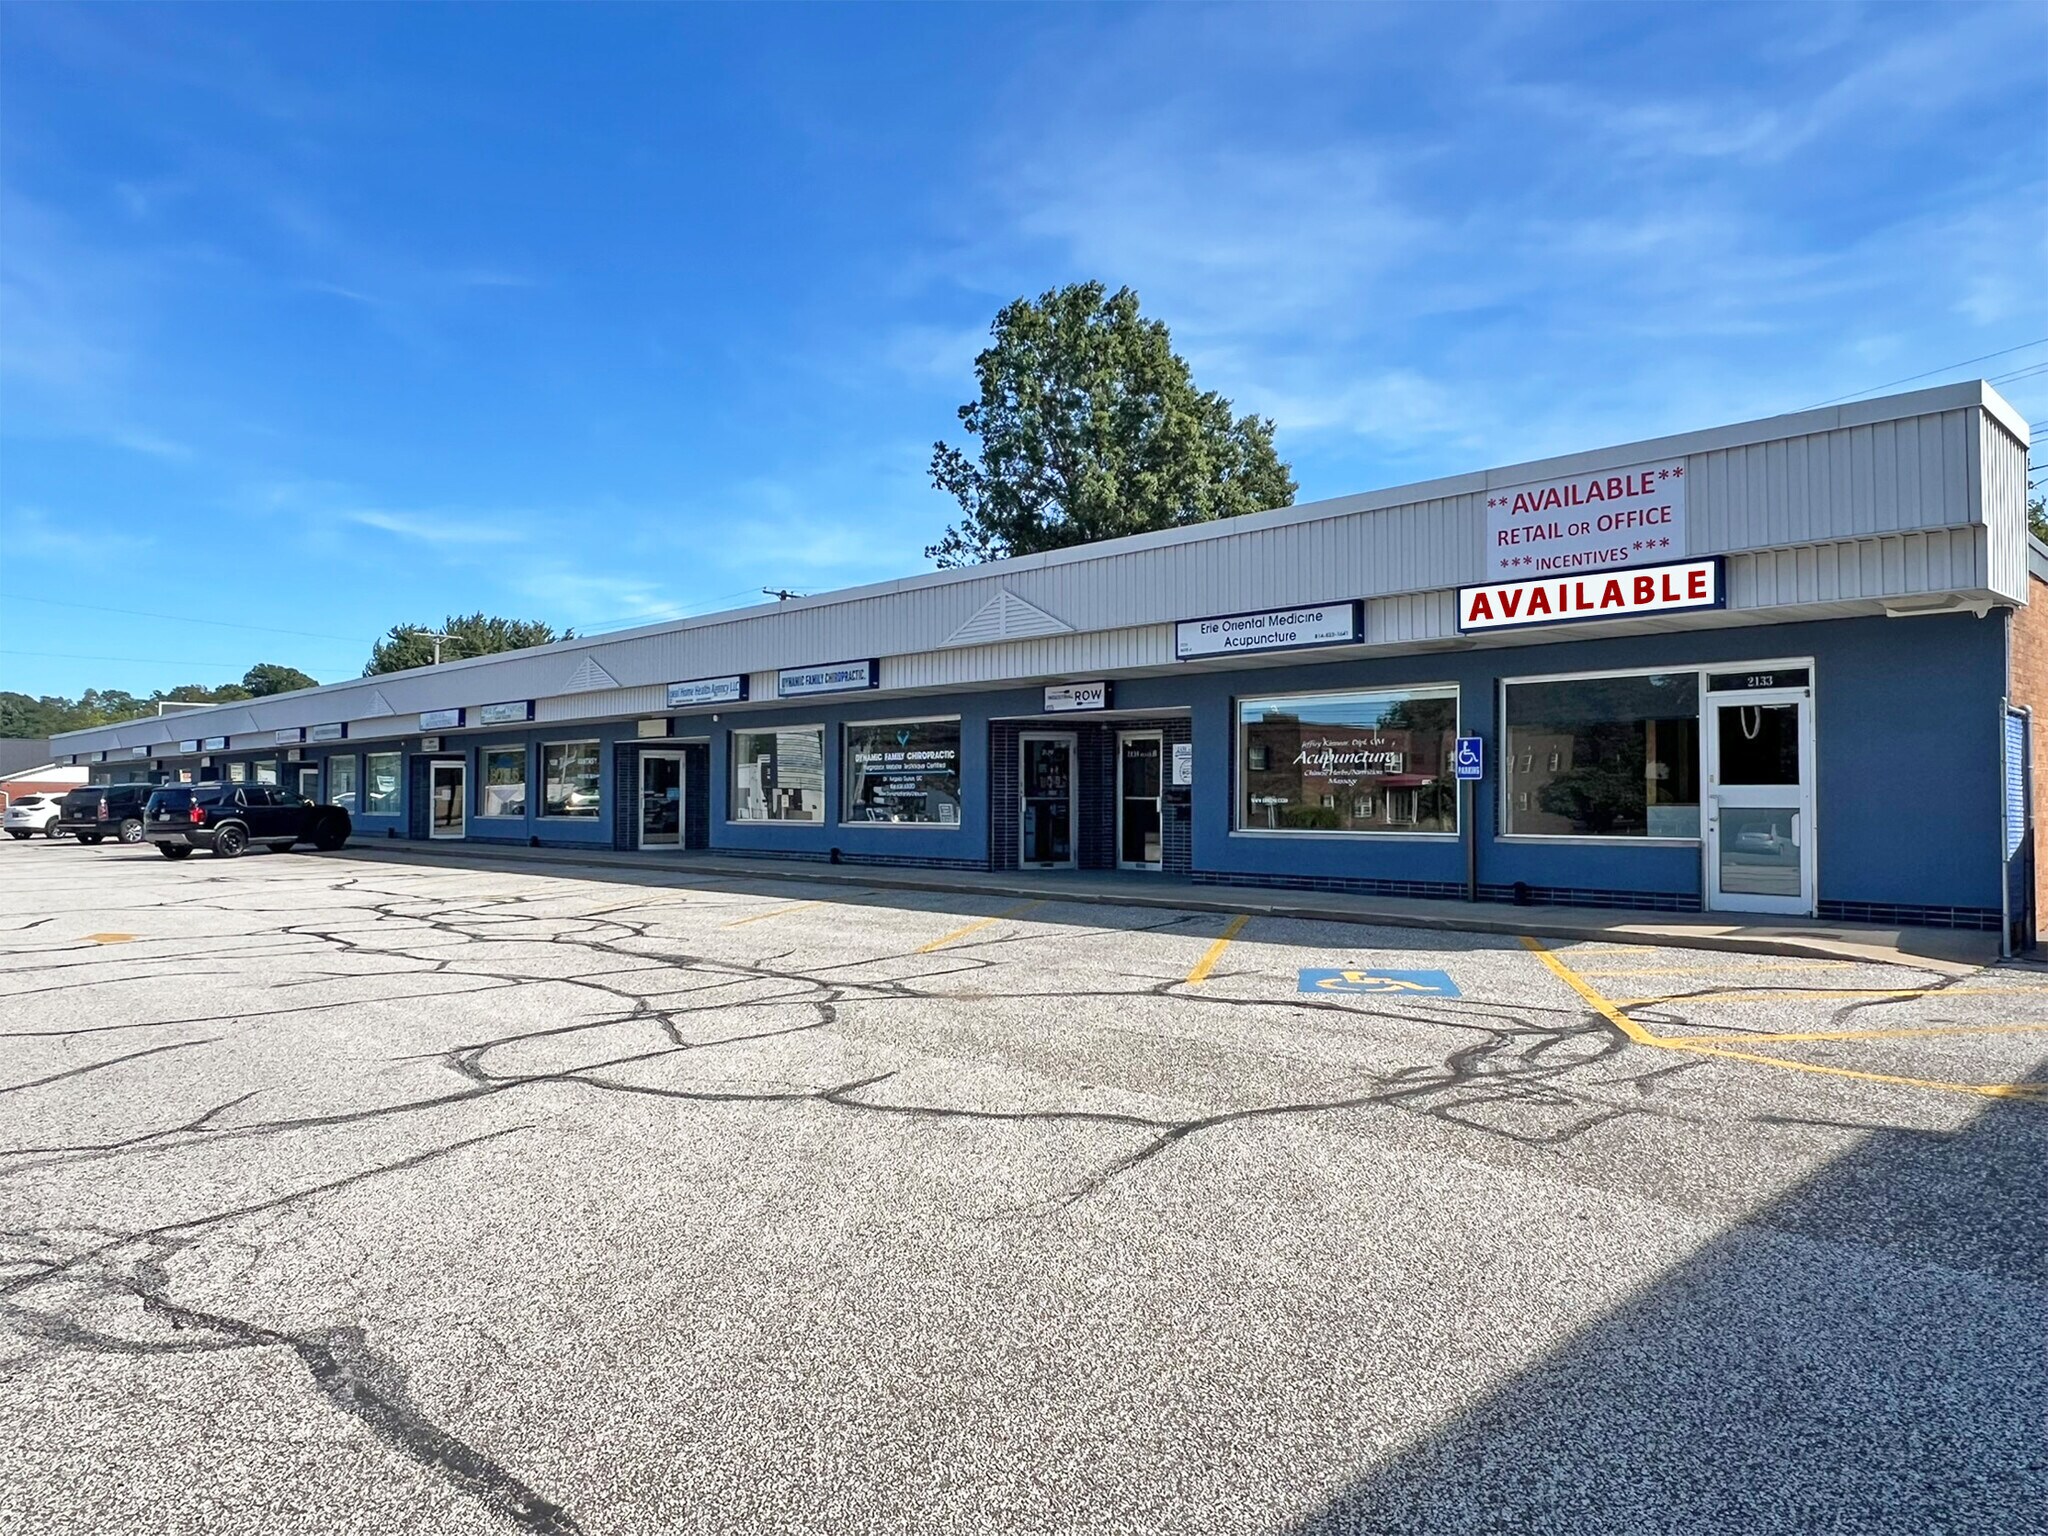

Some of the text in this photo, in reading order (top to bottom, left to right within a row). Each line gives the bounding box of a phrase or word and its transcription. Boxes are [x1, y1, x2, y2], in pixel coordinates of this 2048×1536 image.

[1498, 505, 1672, 546] RETAIL OR OFFICE
[1468, 570, 1707, 621] AVAILABLE
[1201, 611, 1323, 634] Erie Oriental Medicine
[1224, 630, 1297, 648] Acupuncture
[782, 676, 804, 687] DYNAMIC
[806, 673, 824, 685] FAMILY
[1747, 675, 1773, 687] 2133
[680, 688, 694, 697] Home
[711, 684, 729, 697] Agency
[730, 681, 739, 692] LLC
[1075, 689, 1102, 701] ROW
[855, 750, 955, 762] DYNAMIC FAMILY CHIROPRACTIC
[1293, 750, 1395, 768] Acupuncture
[1458, 766, 1479, 774] PARKING
